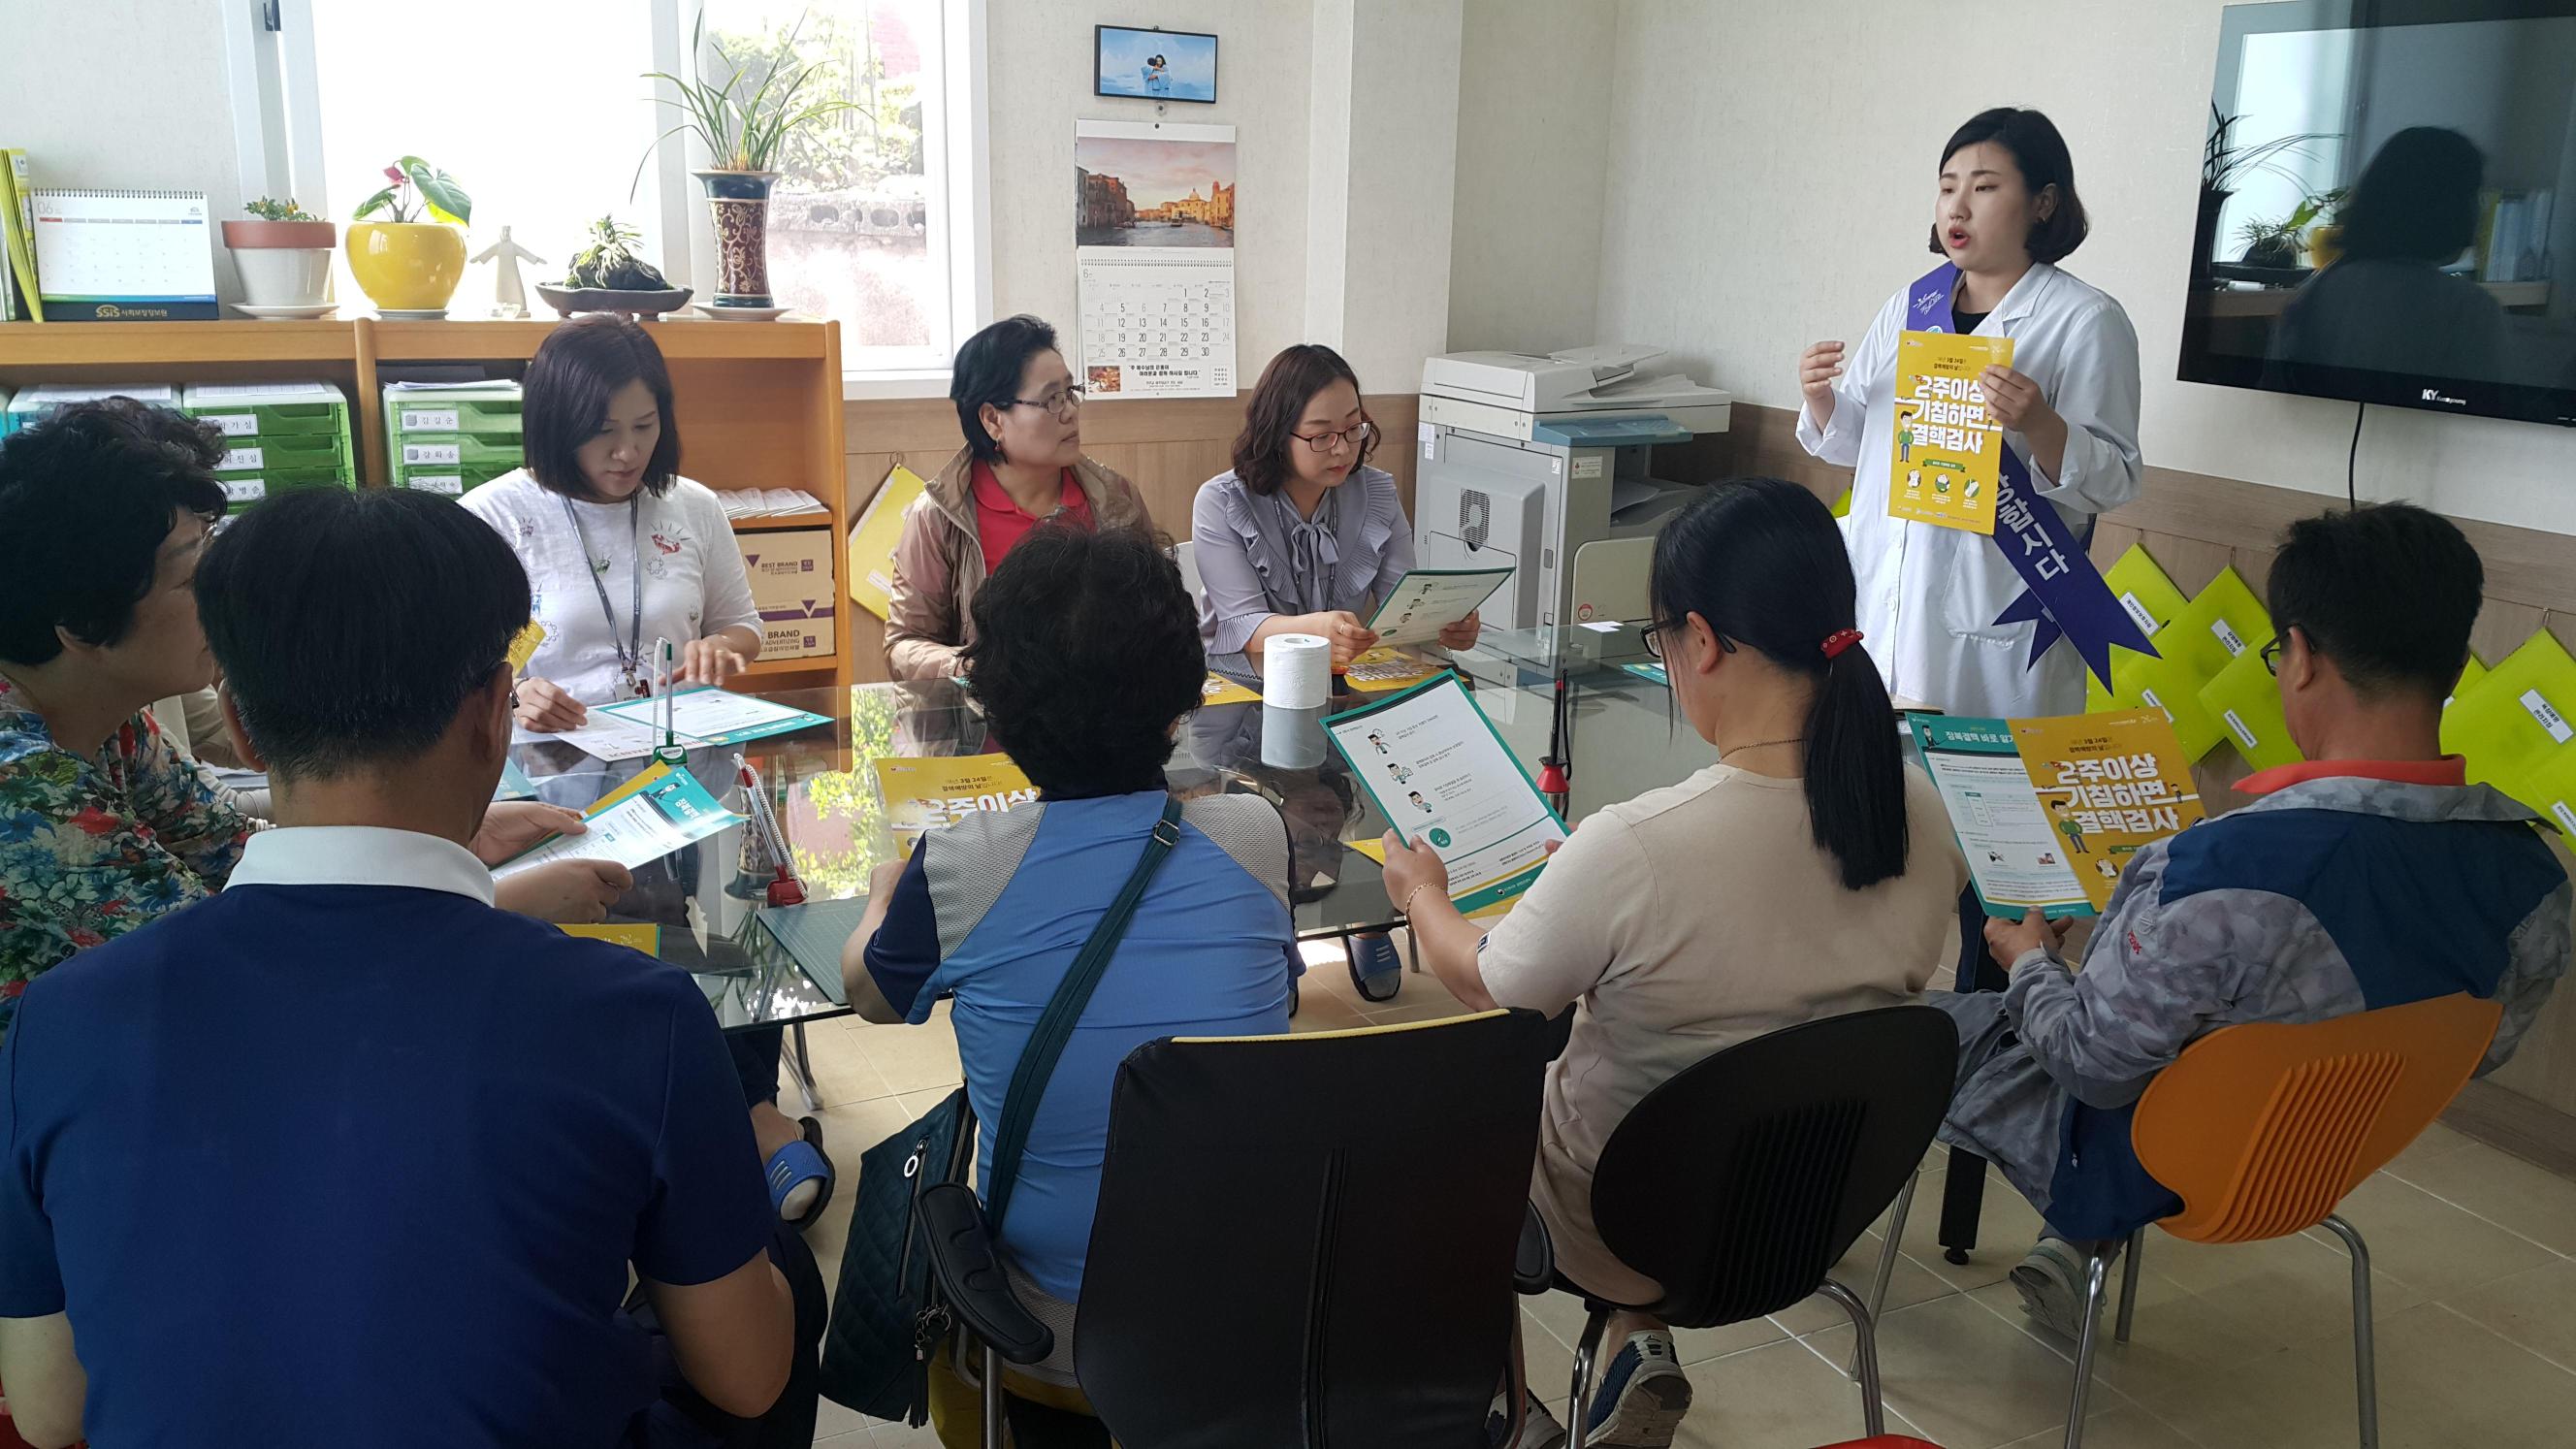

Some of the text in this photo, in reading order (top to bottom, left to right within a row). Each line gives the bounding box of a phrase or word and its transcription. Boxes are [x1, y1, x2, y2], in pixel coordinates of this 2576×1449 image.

[1098, 318, 1230, 328] 11 12 13 14 15 16 17
[1098, 333, 1230, 342] 18 19 20 21 22 23 24
[1098, 348, 1209, 358] 25 26 27 28 29 30
[1915, 374, 1985, 403] 2주이상
[2422, 388, 2439, 401] KY
[1912, 400, 1985, 428] 기침하면
[1912, 423, 1983, 454] 결핵검사
[767, 629, 800, 639] BRAND
[2057, 753, 2159, 785] 2주이상
[2066, 779, 2167, 809] 기침하면
[2071, 806, 2180, 834] 결핵검사
